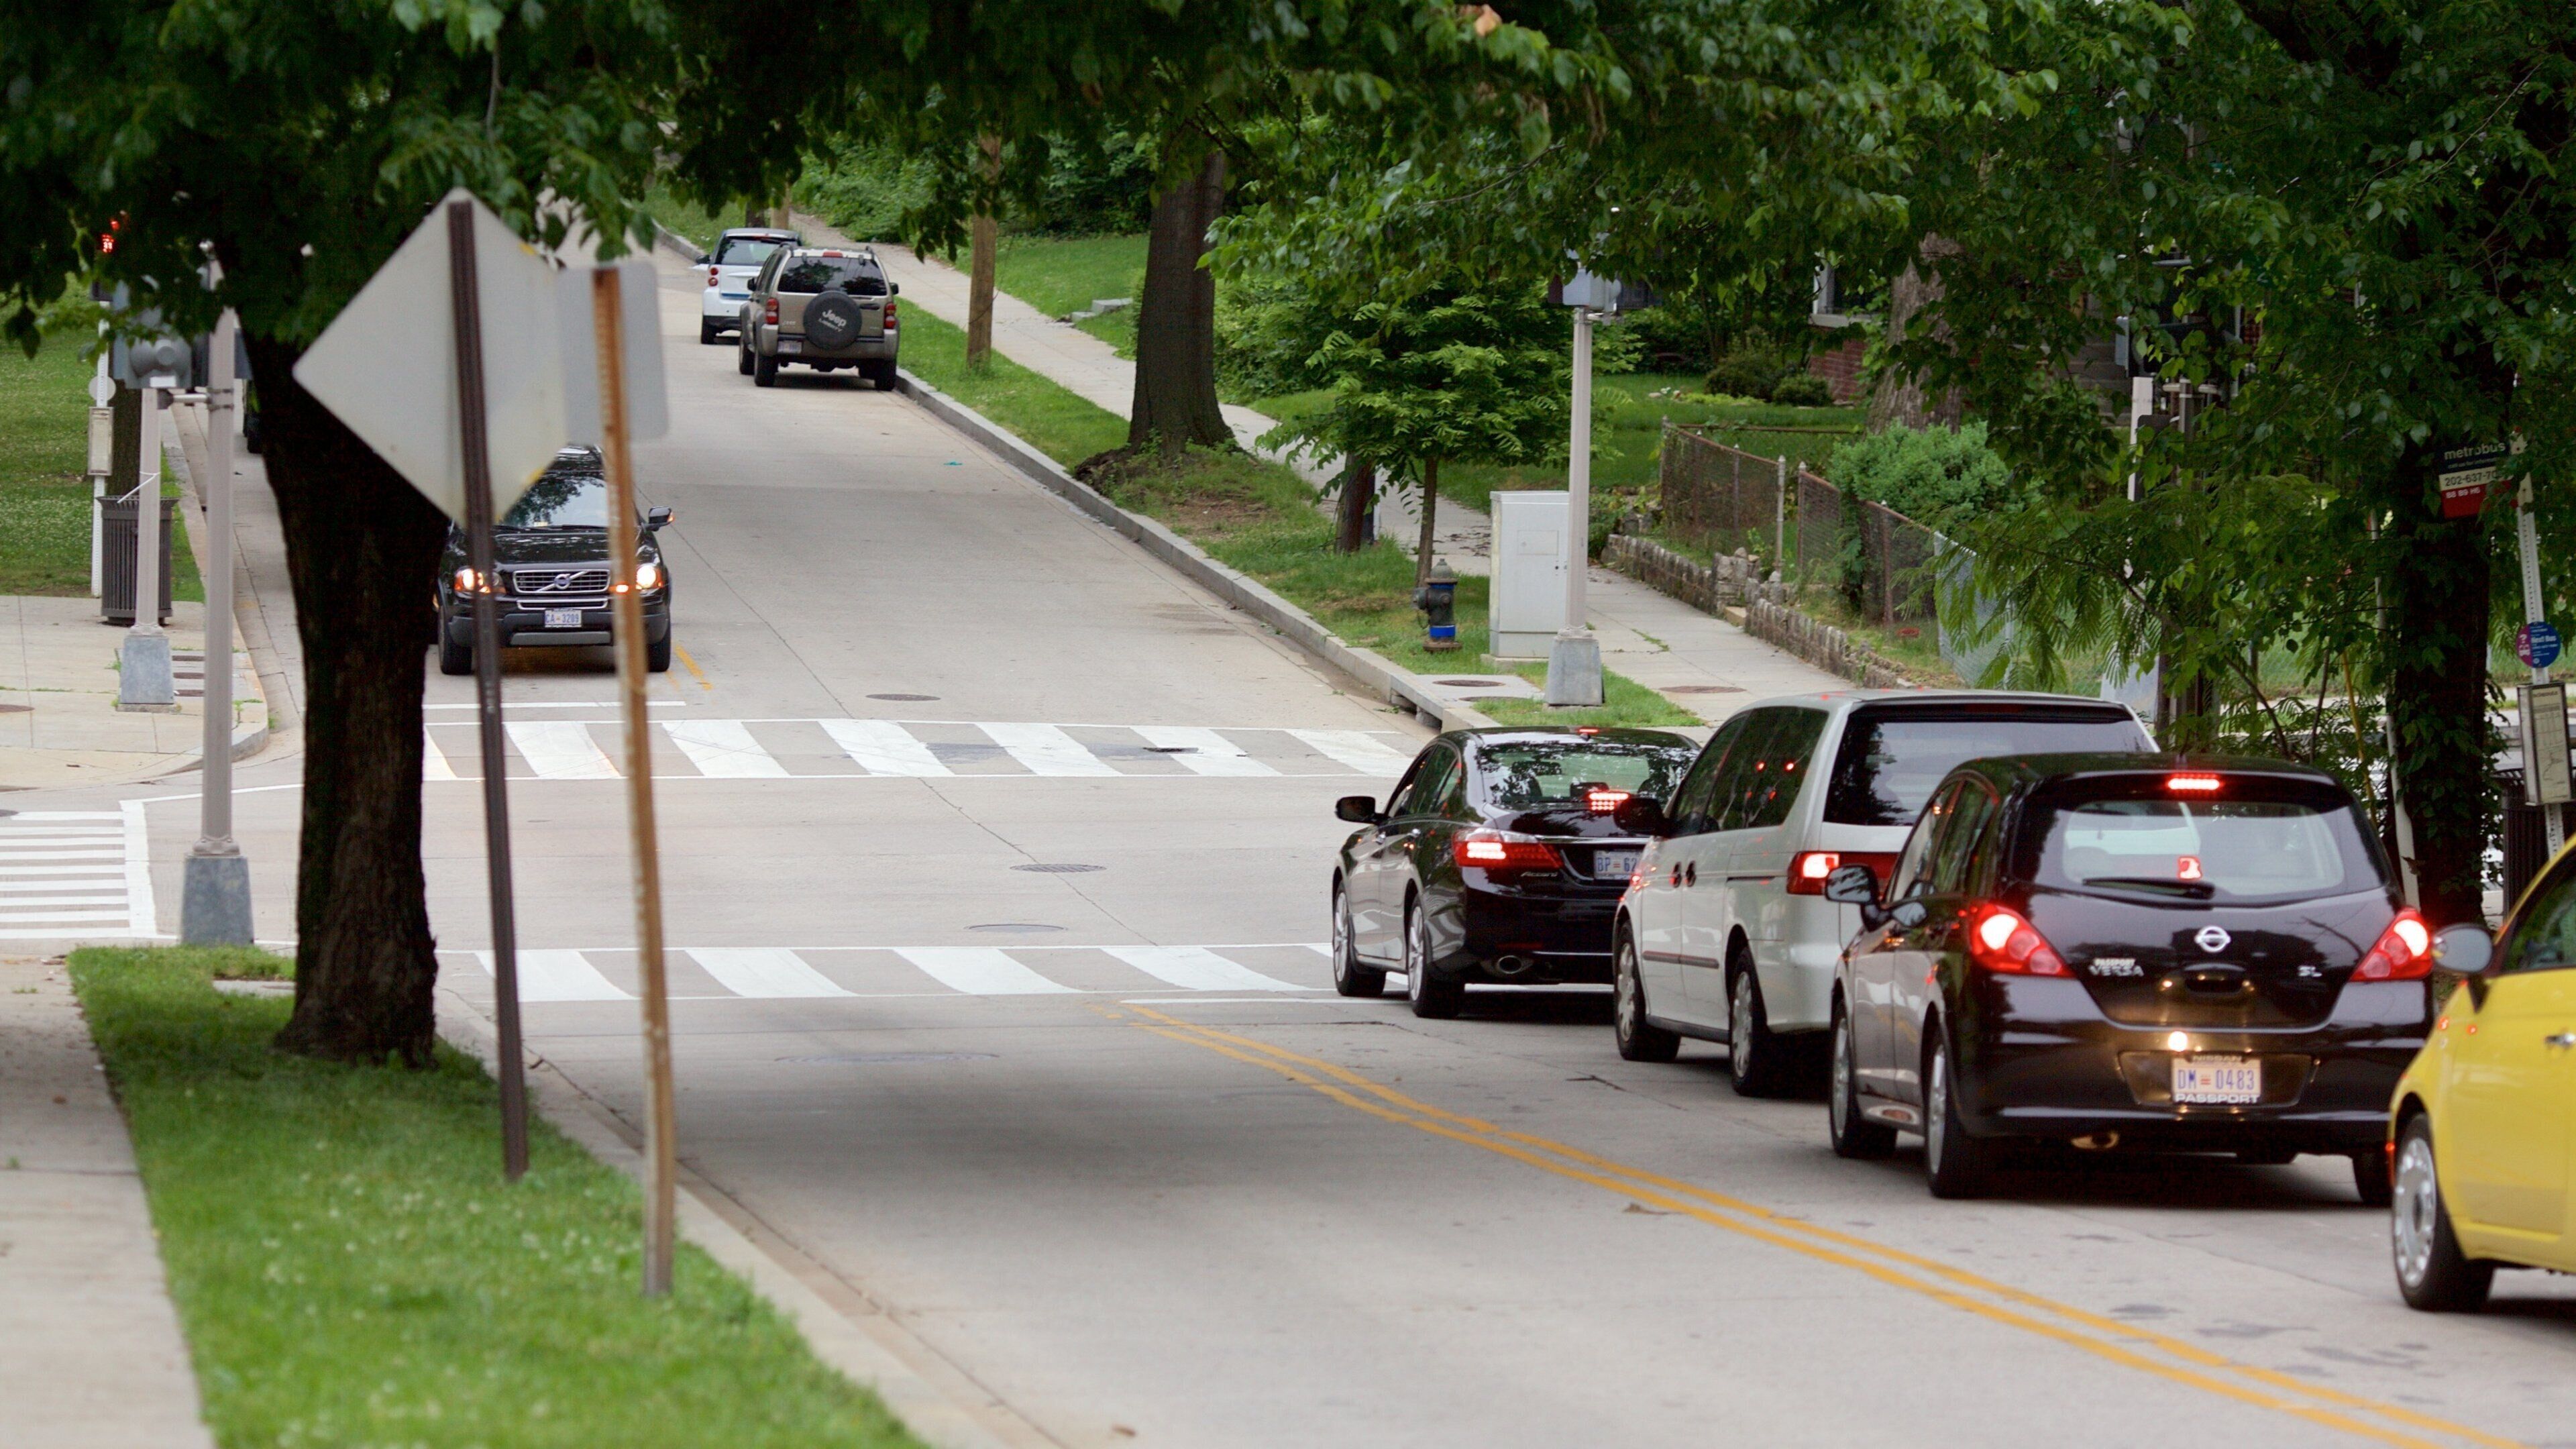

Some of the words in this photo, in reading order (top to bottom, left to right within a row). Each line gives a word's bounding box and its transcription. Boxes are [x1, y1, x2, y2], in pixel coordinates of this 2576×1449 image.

[822, 309, 847, 327] Jeep
[2444, 443, 2506, 460] metrobus
[2445, 471, 2500, 486] 202-637-70
[1597, 857, 1611, 871] BP
[1624, 857, 1637, 871] 62
[2088, 965, 2144, 977] VERSA
[2298, 966, 2322, 977] SL
[2216, 1069, 2254, 1089] 0483
[2175, 1093, 2261, 1104] PASSPORT
